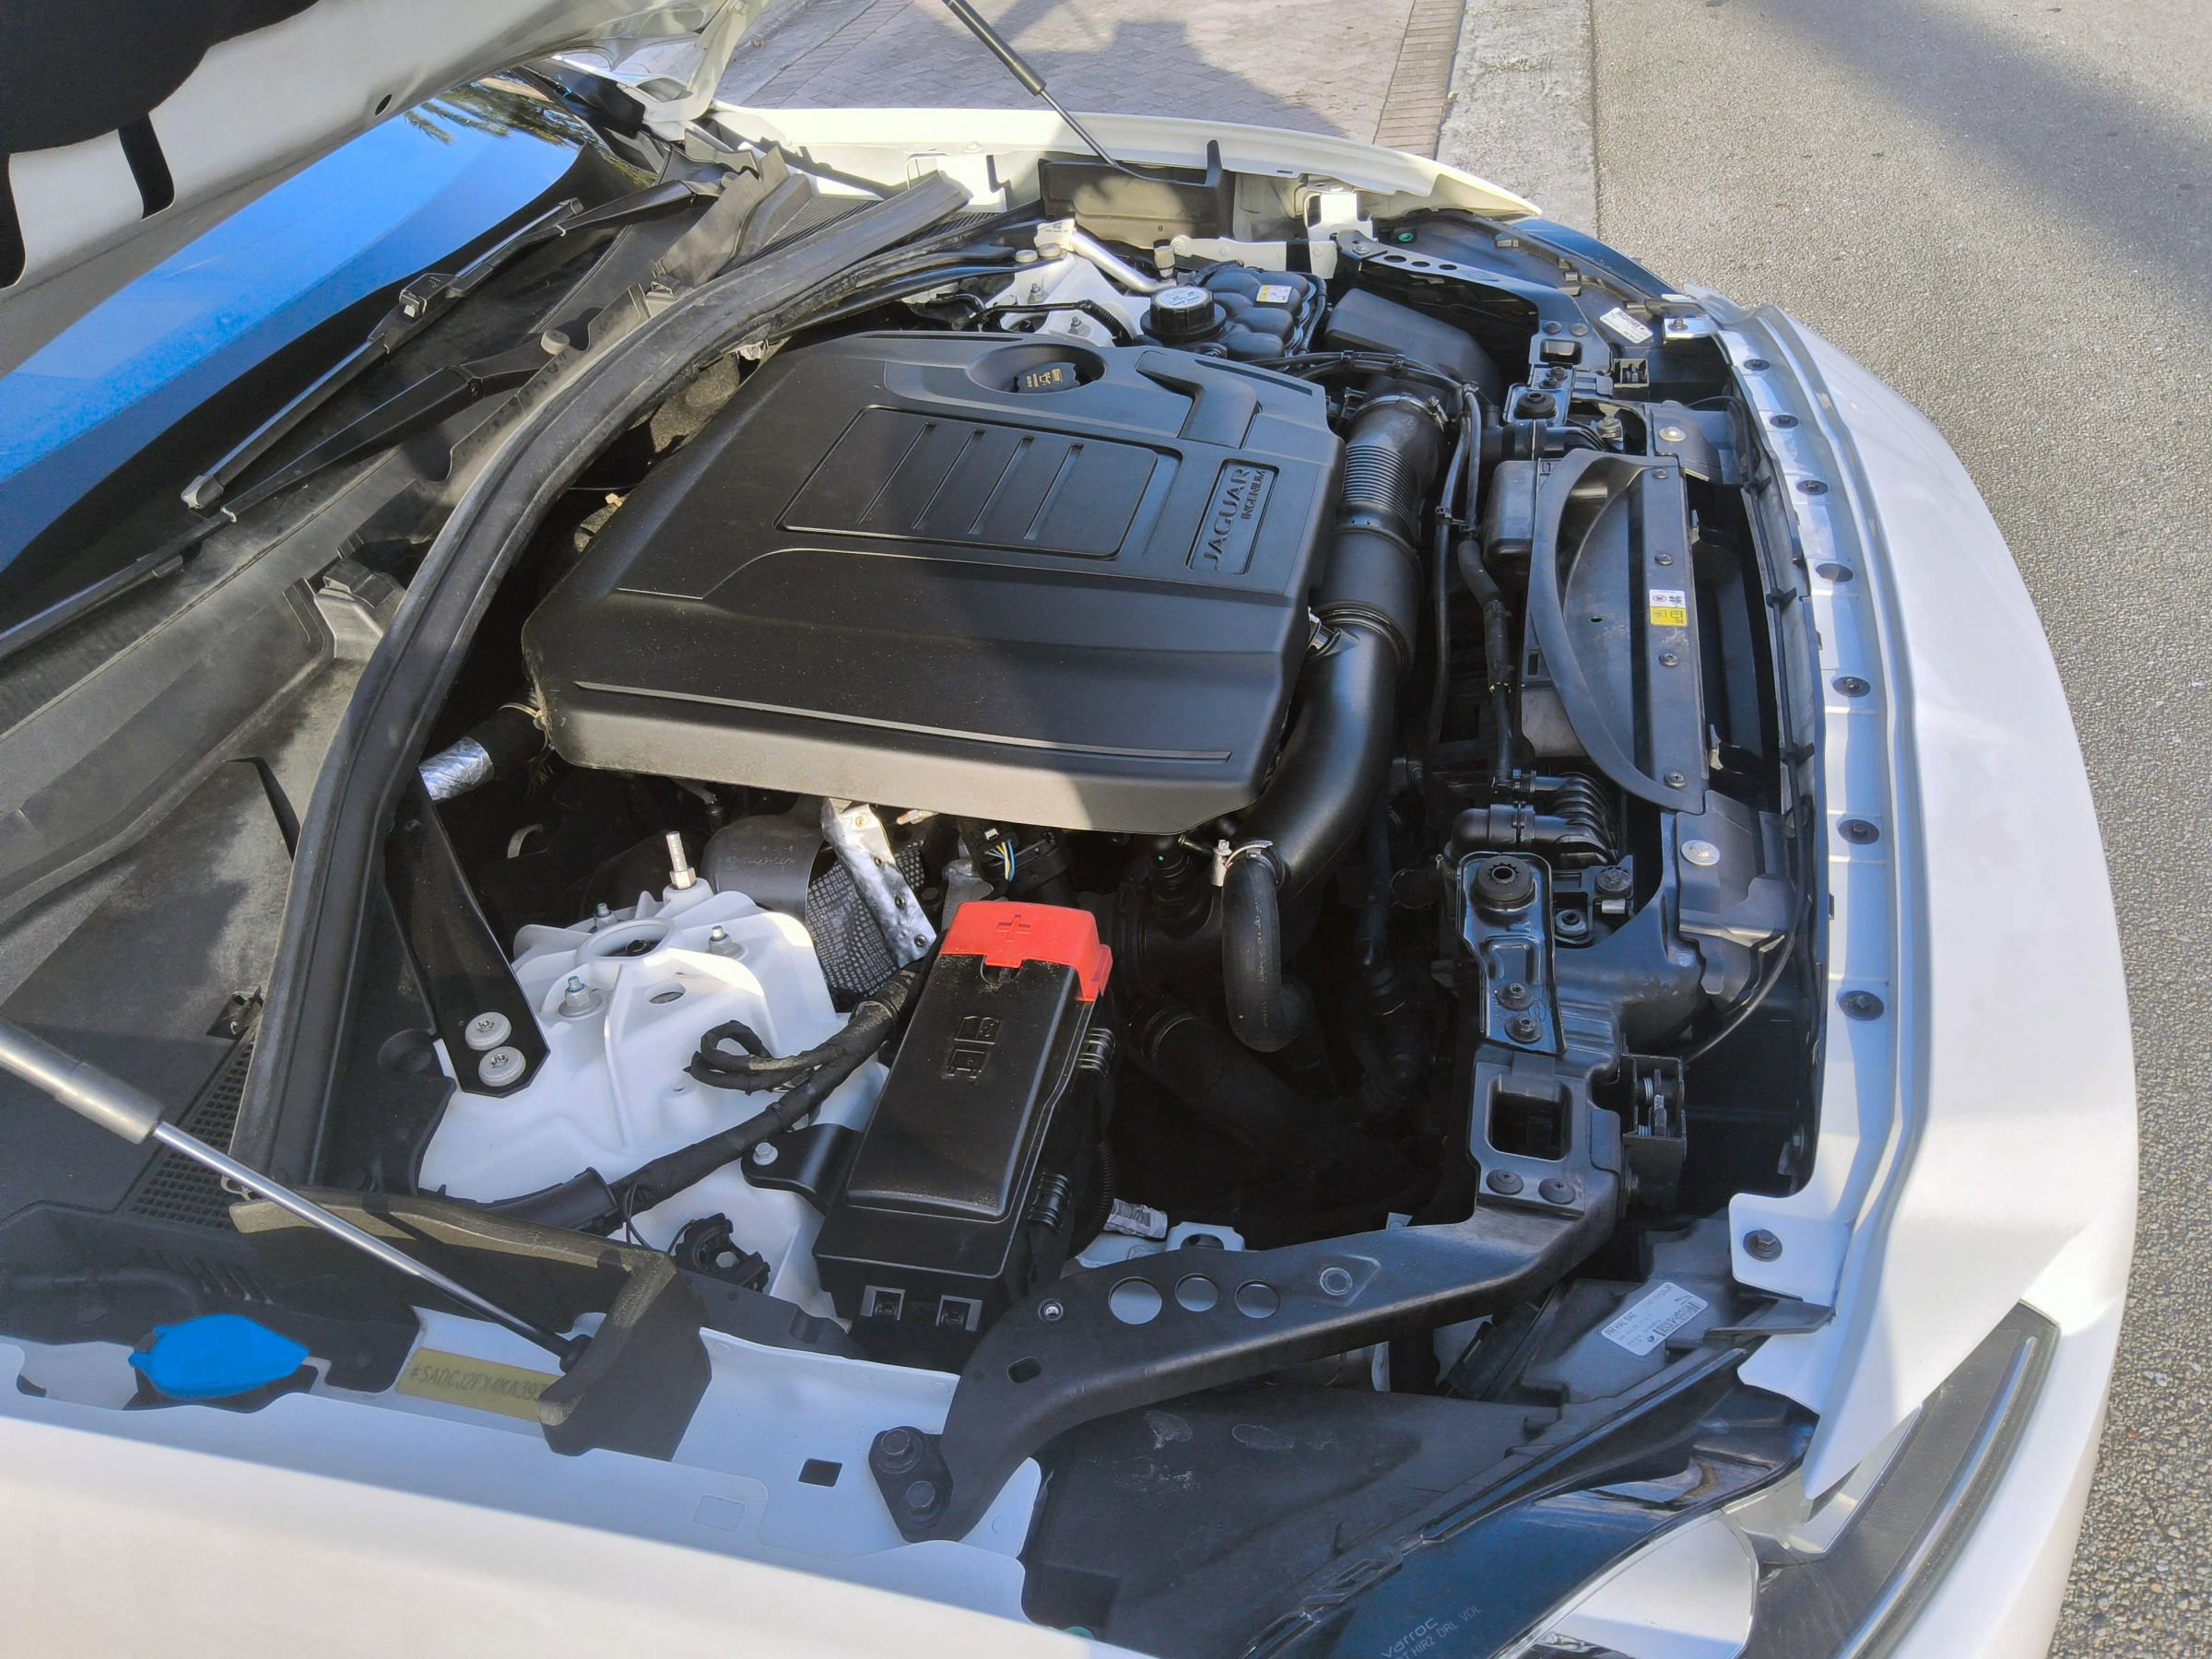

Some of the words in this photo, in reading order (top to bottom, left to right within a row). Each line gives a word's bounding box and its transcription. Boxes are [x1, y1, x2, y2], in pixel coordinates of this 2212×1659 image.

[1204, 468, 1251, 570] JAGUAR
[1241, 470, 1266, 519] INGENIUM
[1381, 1617, 1439, 1658] varroc
[1410, 1636, 1436, 1657] HIR2
[1436, 1620, 1459, 1639] DRL
[1458, 1605, 1483, 1621] VOL
